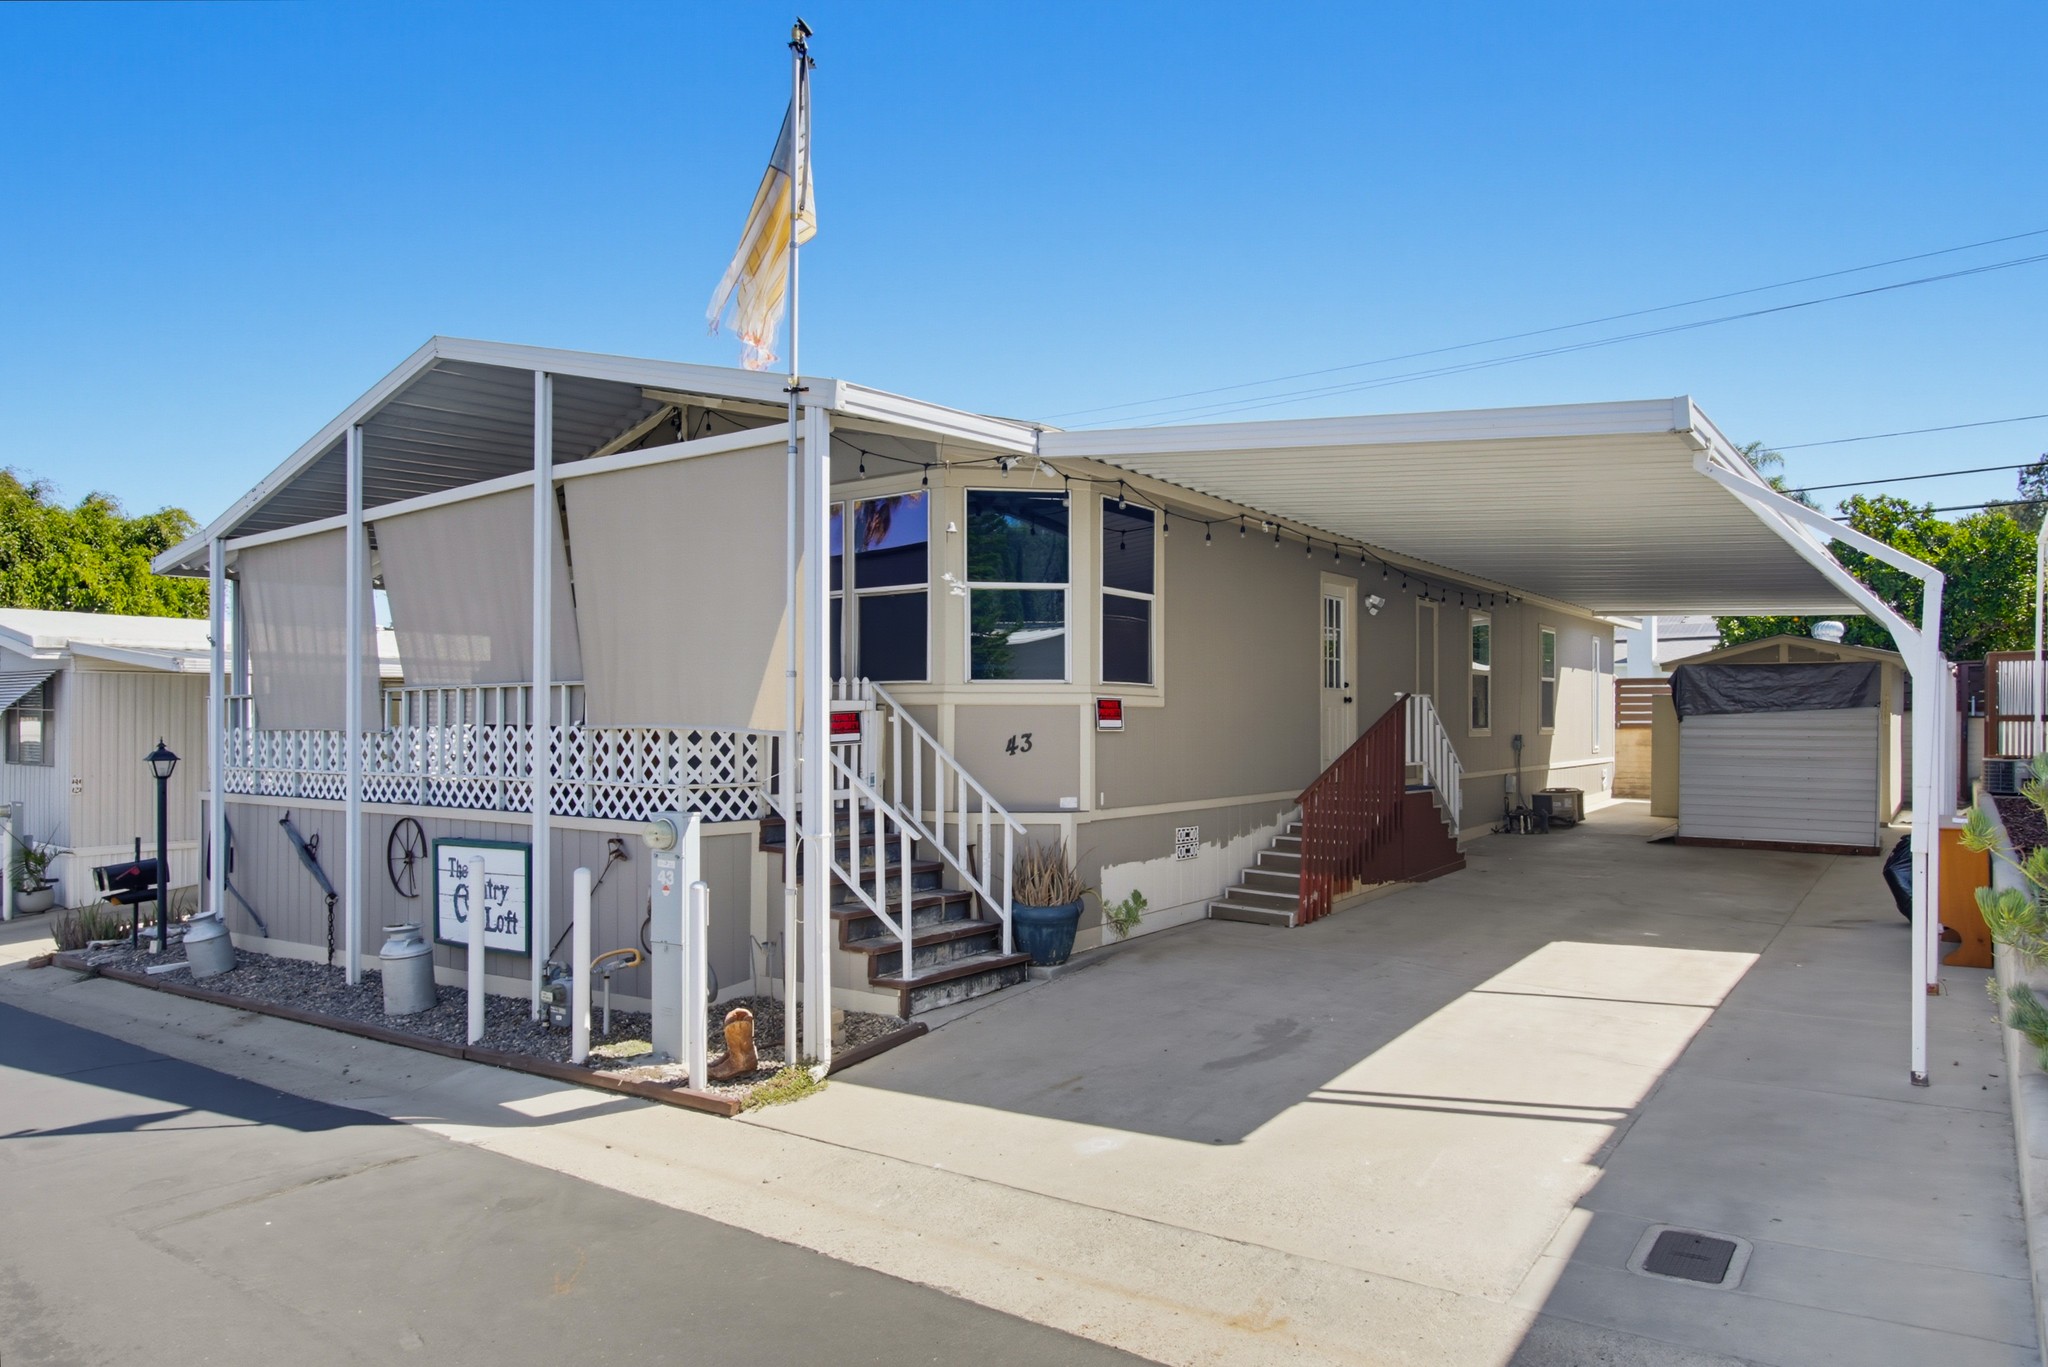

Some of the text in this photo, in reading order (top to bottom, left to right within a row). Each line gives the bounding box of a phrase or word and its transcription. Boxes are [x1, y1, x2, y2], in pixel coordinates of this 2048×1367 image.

[1005, 732, 1033, 756] 43
[448, 857, 469, 880] The
[657, 870, 675, 886] 43
[484, 906, 519, 935] Loft
